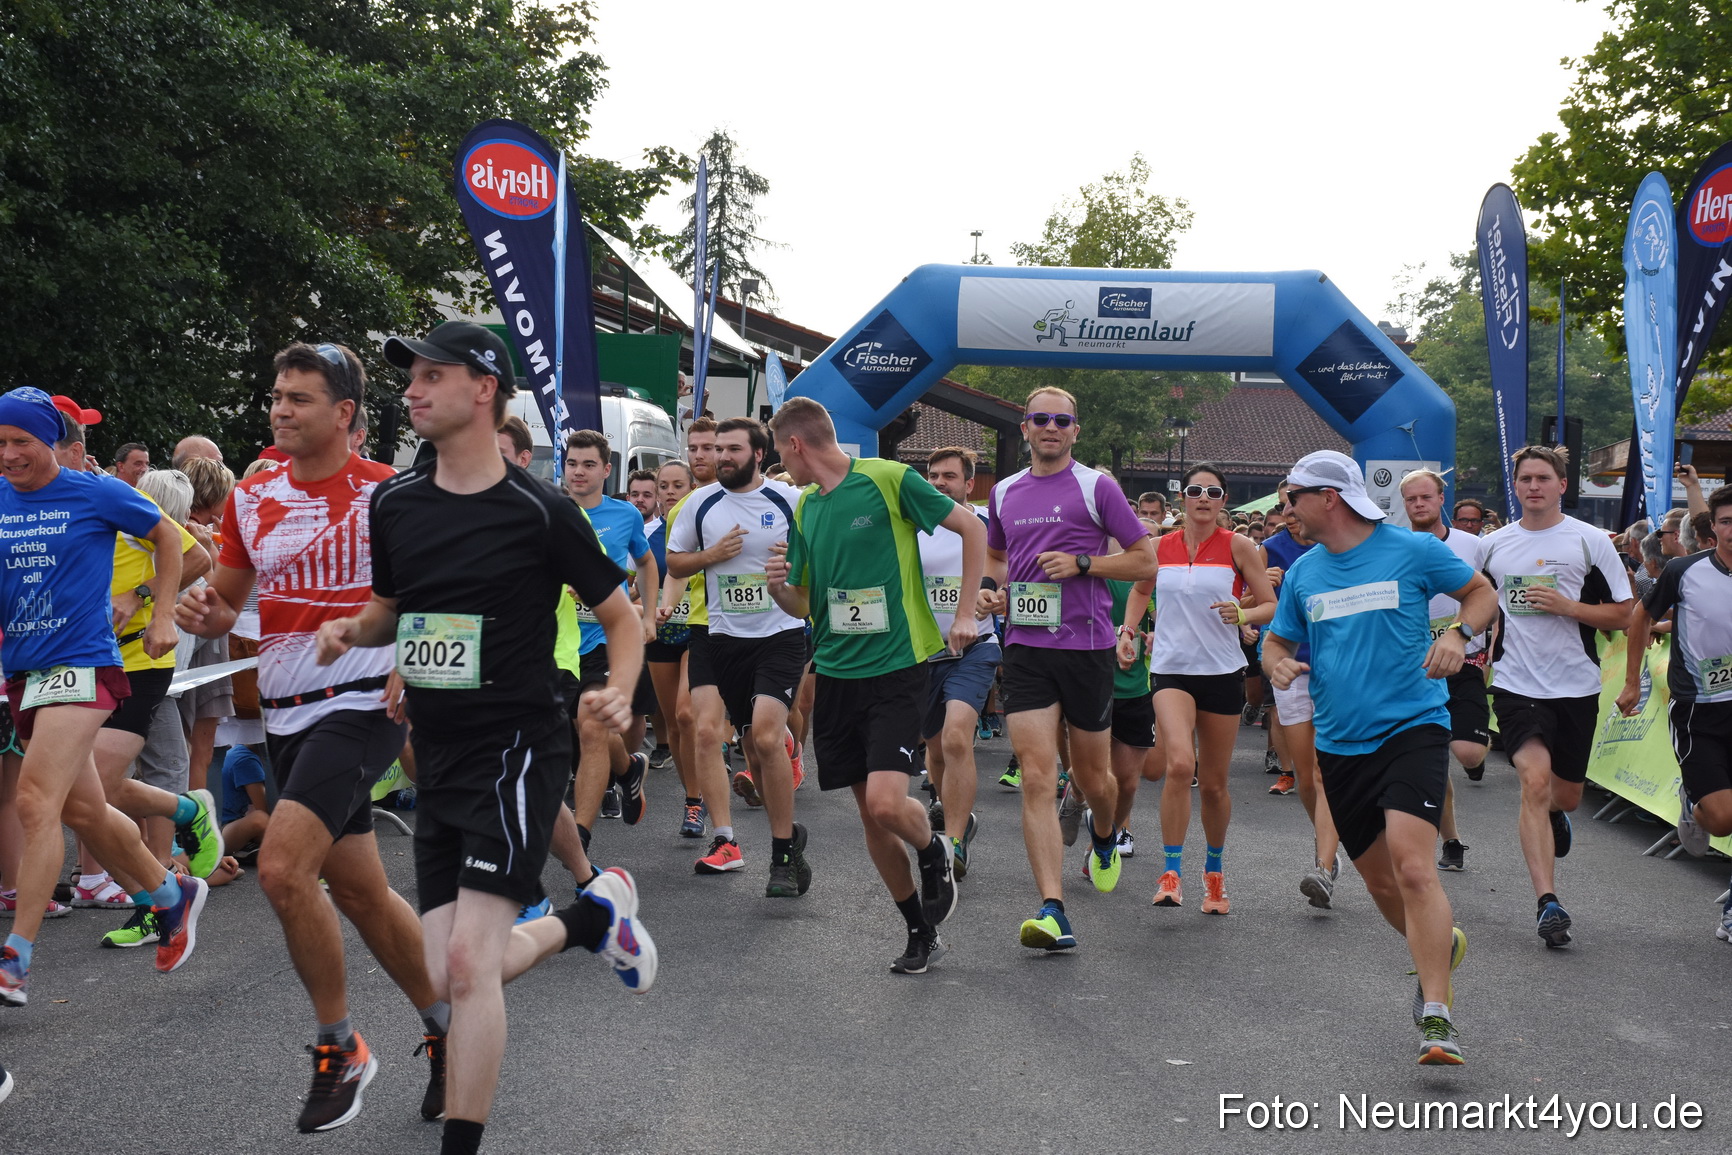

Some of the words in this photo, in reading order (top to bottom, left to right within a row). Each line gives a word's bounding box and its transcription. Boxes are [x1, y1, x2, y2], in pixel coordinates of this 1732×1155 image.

[1110, 298, 1148, 308] Fischer
[1079, 318, 1195, 341] firmenlauf
[1078, 340, 1126, 349] neumarkt
[856, 351, 917, 366] Fischer
[1337, 362, 1354, 371] das
[26, 513, 37, 521] es
[40, 510, 70, 521] beim
[850, 515, 873, 527] AOK
[1014, 518, 1027, 526] WIR
[1028, 517, 1044, 525] SIND
[11, 542, 47, 554] richtig
[5, 555, 57, 569] LAUFEN
[23, 572, 43, 584] soll!
[725, 586, 763, 603] 1881
[930, 588, 960, 603] 188
[1366, 589, 1396, 598] Volksschule
[1017, 597, 1048, 614] 900
[849, 605, 861, 622] 2
[404, 640, 466, 668] 2002
[38, 670, 77, 694] 720
[1708, 668, 1732, 685] 22
[473, 859, 498, 873] JAKO
